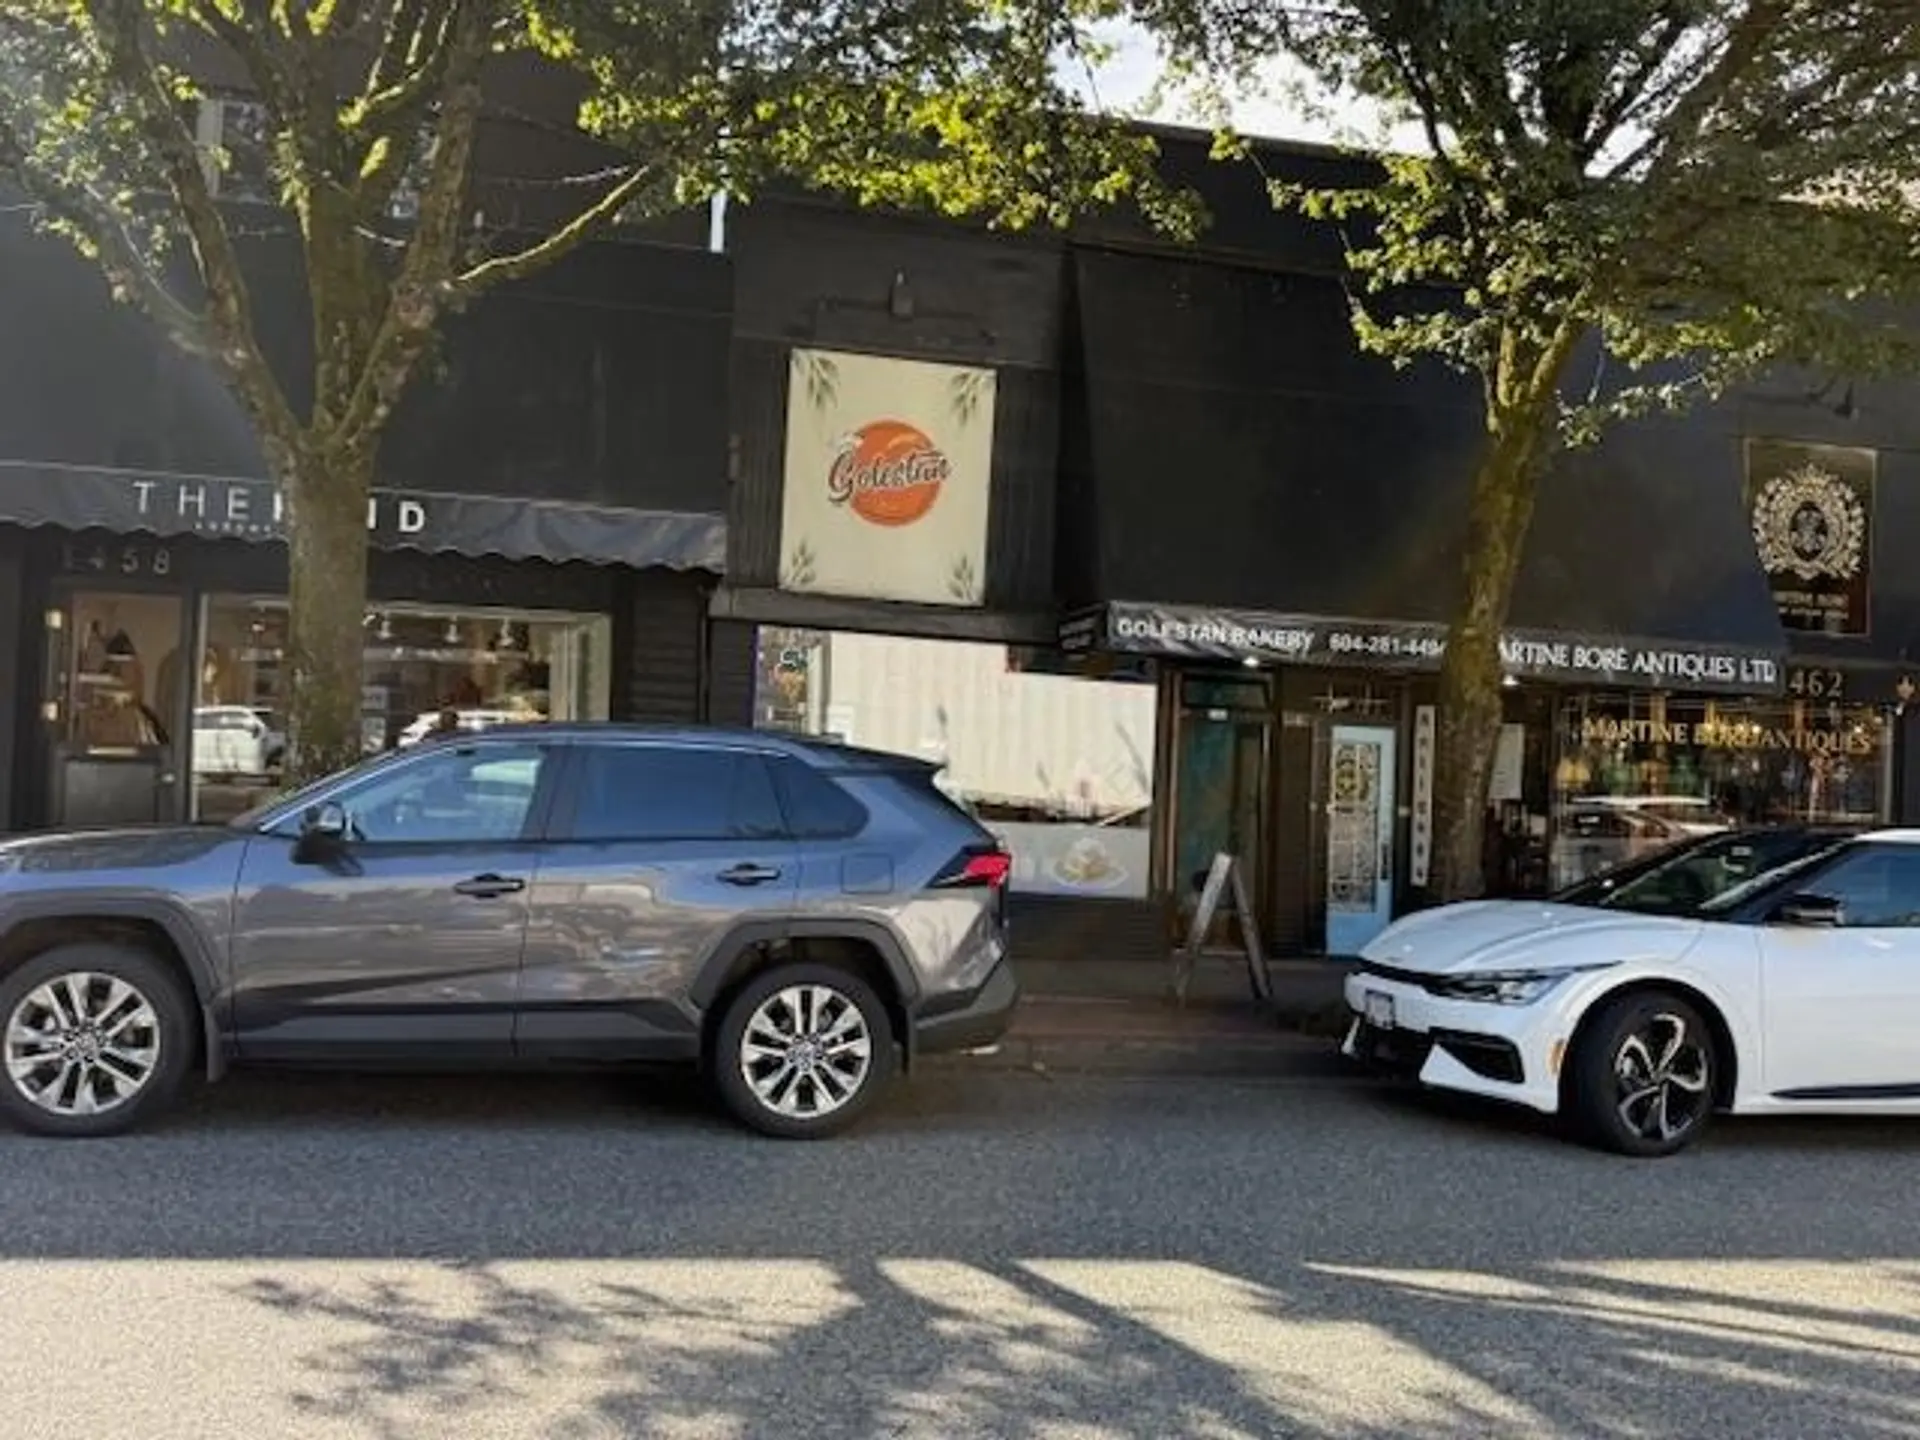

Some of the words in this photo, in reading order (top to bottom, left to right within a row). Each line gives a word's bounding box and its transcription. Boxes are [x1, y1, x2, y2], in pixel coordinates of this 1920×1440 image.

[828, 441, 952, 503] Golestan
[133, 480, 251, 521] THE
[1117, 616, 1226, 643] GOLESTAN
[1229, 627, 1315, 652] BAKERY
[1498, 636, 1570, 668] ARTINE
[1632, 651, 1736, 681] ANTIQUES
[1740, 657, 1777, 683] LTD
[1788, 668, 1843, 698] 462
[1582, 716, 1689, 745] MARTINE
[1761, 729, 1872, 757] ANTIQUES
